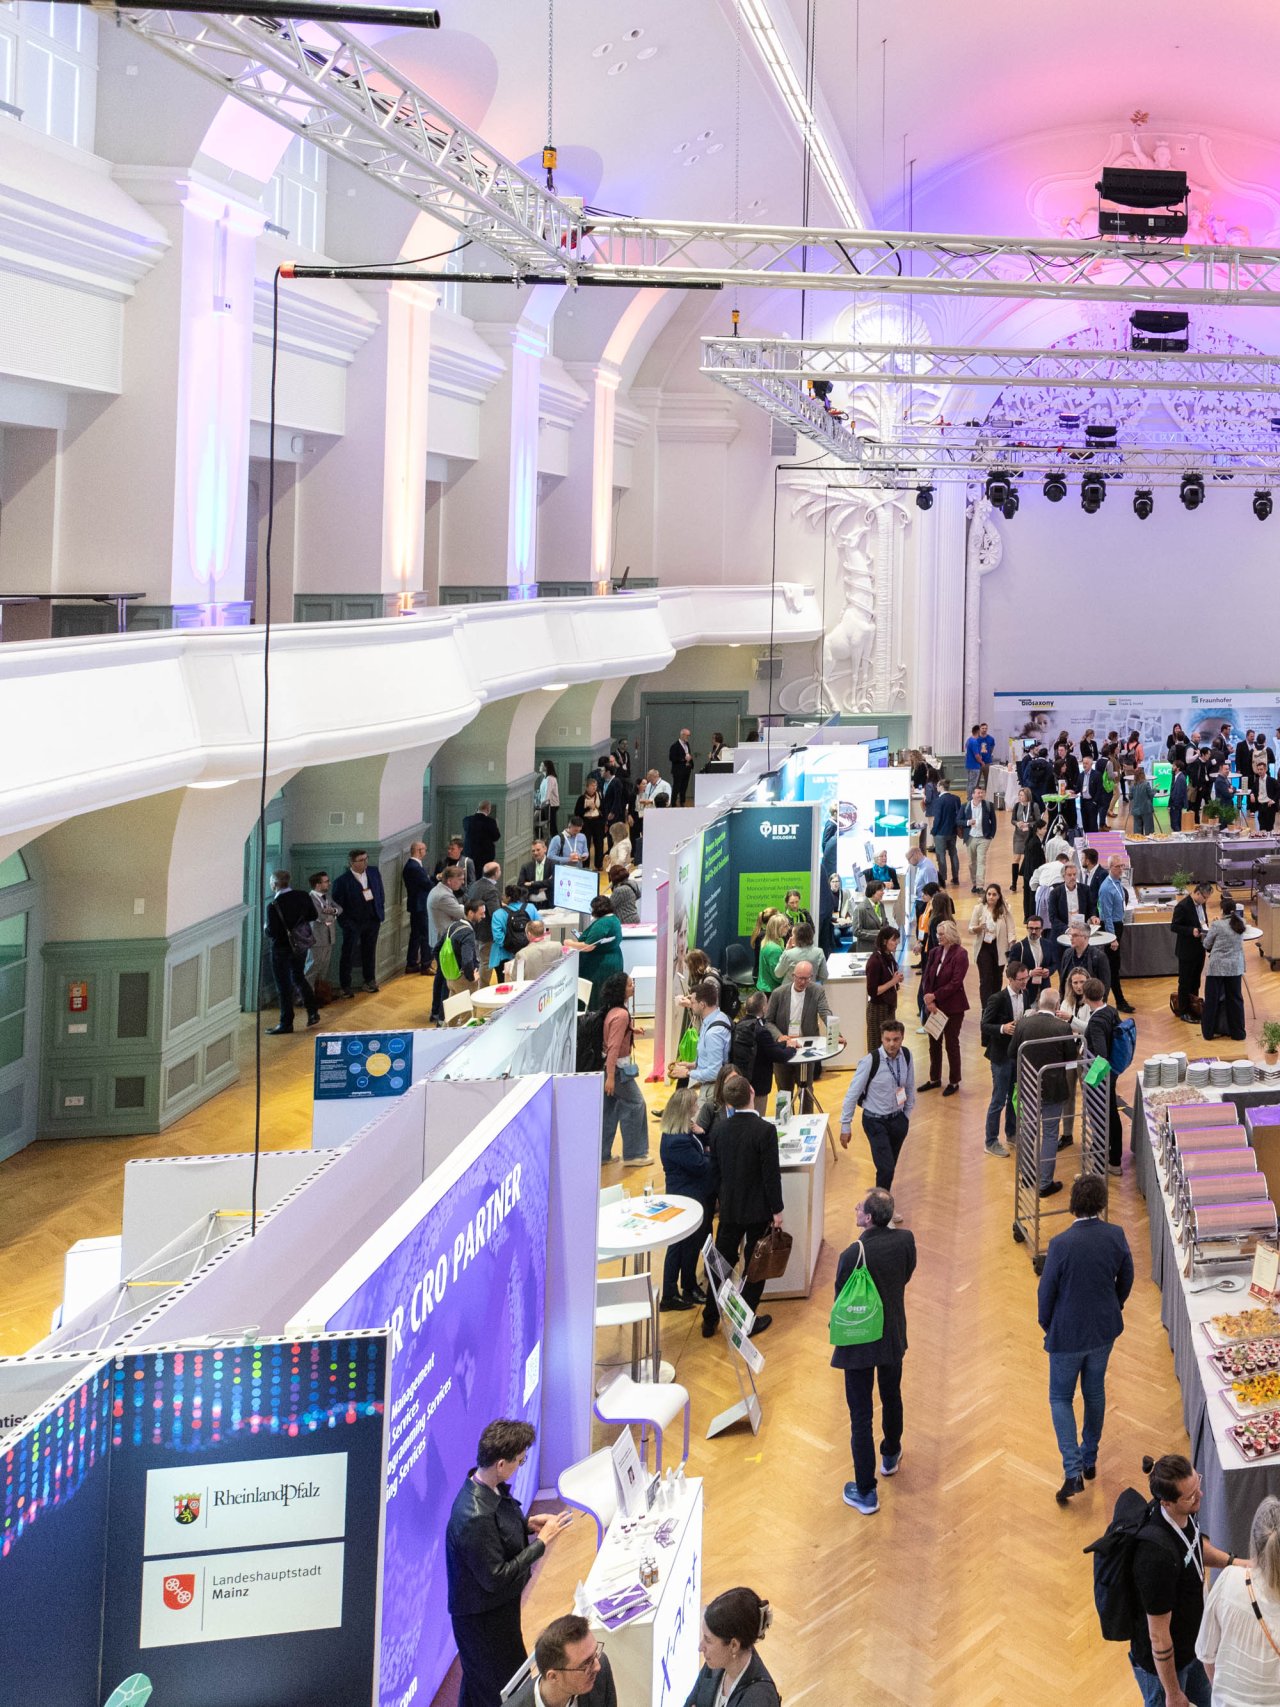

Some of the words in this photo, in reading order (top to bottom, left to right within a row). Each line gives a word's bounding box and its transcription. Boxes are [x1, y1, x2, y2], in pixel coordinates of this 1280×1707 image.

[772, 824, 800, 835] IDT
[411, 1253, 448, 1333] CRO
[452, 1162, 522, 1284] PARTNER
[391, 1352, 435, 1422] Management
[427, 1376, 452, 1421] Services
[391, 1399, 420, 1445] Services
[399, 1436, 426, 1484] Services
[212, 1565, 322, 1586] Landeshauptstadt
[212, 1587, 249, 1600] Mainz
